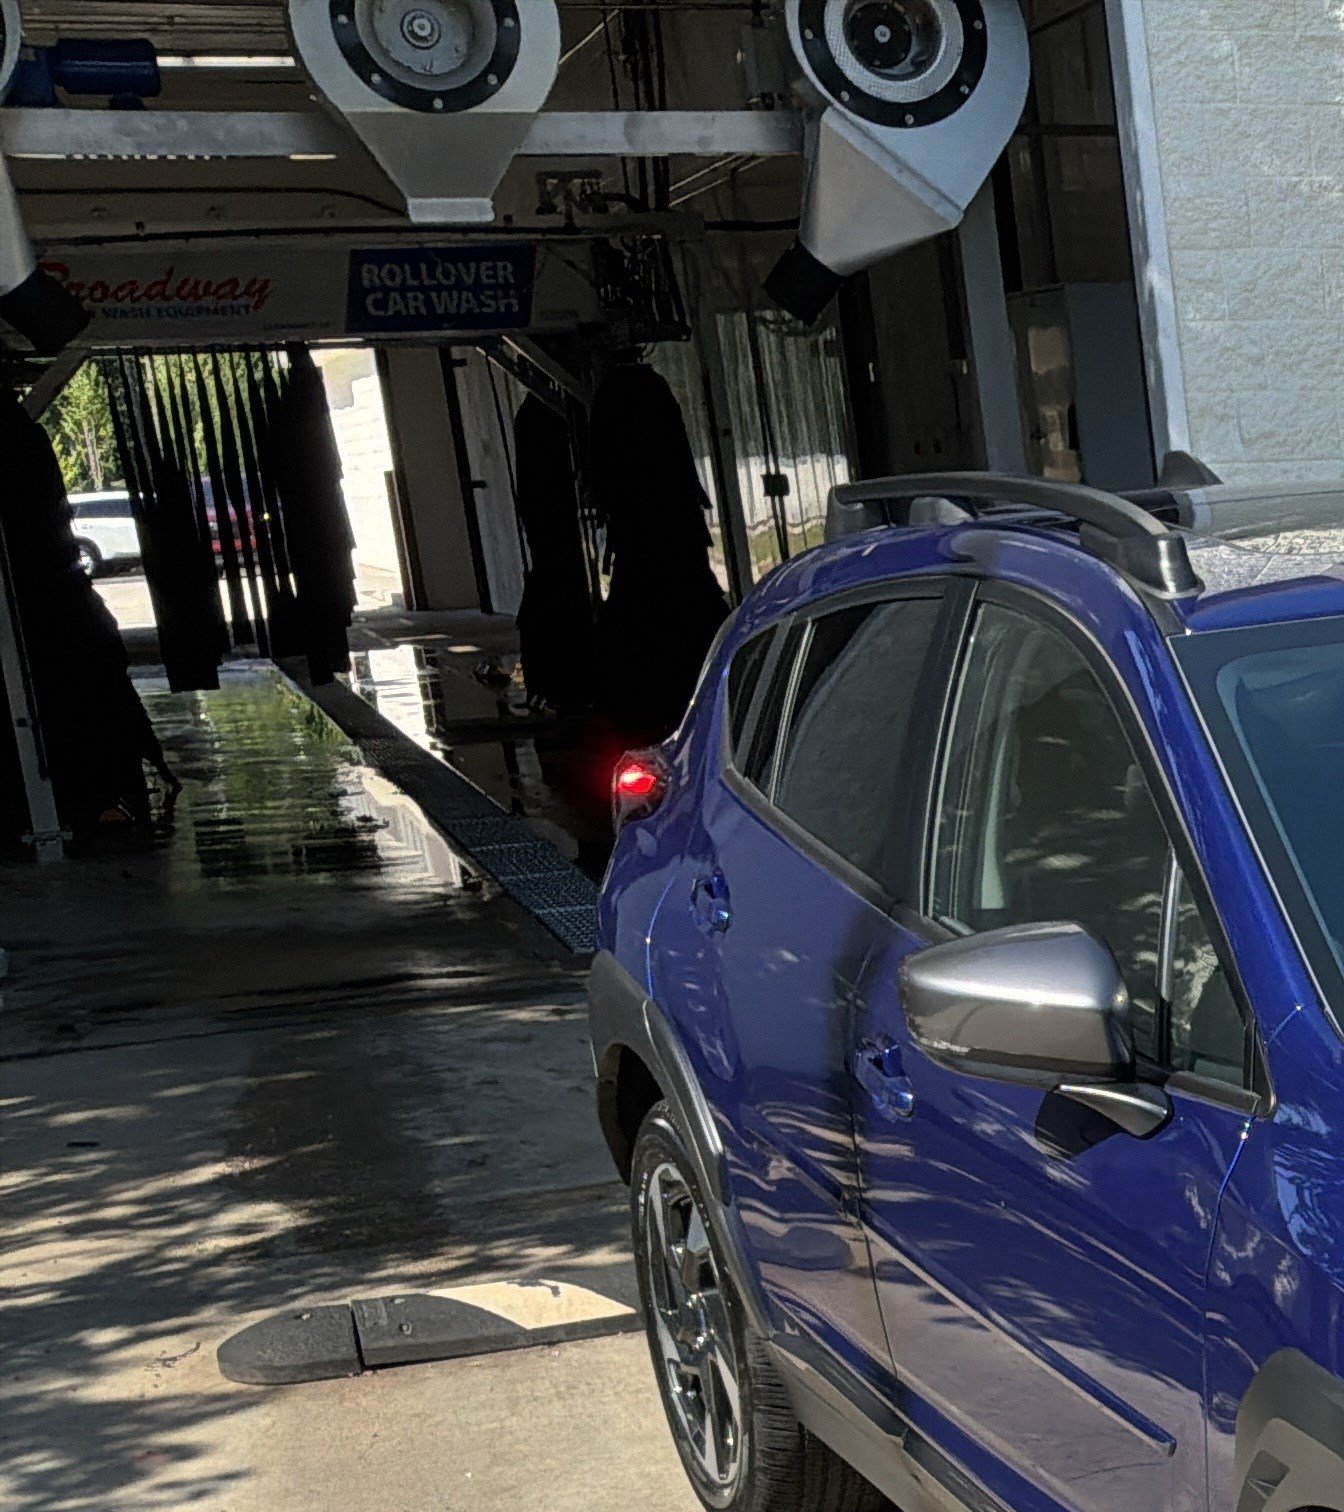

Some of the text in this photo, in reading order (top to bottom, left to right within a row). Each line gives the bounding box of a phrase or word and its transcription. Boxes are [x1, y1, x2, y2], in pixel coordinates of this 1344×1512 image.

[360, 260, 516, 288] ROLLOVER
[102, 307, 152, 320] WASH
[156, 303, 251, 318] EQUIPMENT
[365, 288, 520, 317] CAR WASH
